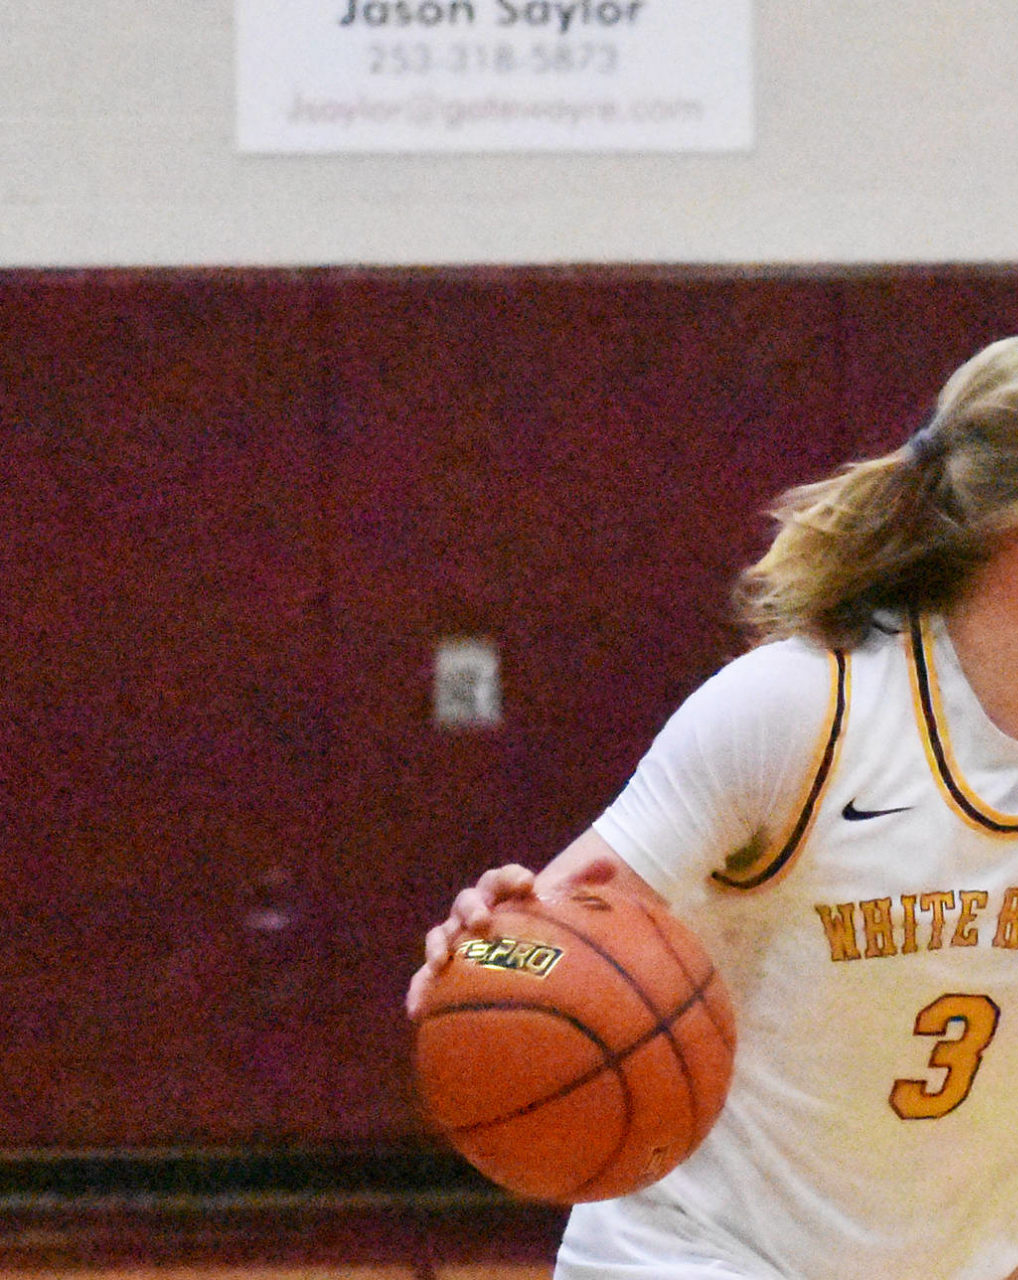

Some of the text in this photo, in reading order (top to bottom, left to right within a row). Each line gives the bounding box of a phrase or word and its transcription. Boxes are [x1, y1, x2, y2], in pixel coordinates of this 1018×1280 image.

[339, 0, 643, 35] Jason Saylor
[814, 888, 988, 962] WHITE
[888, 993, 1001, 1120] 3
